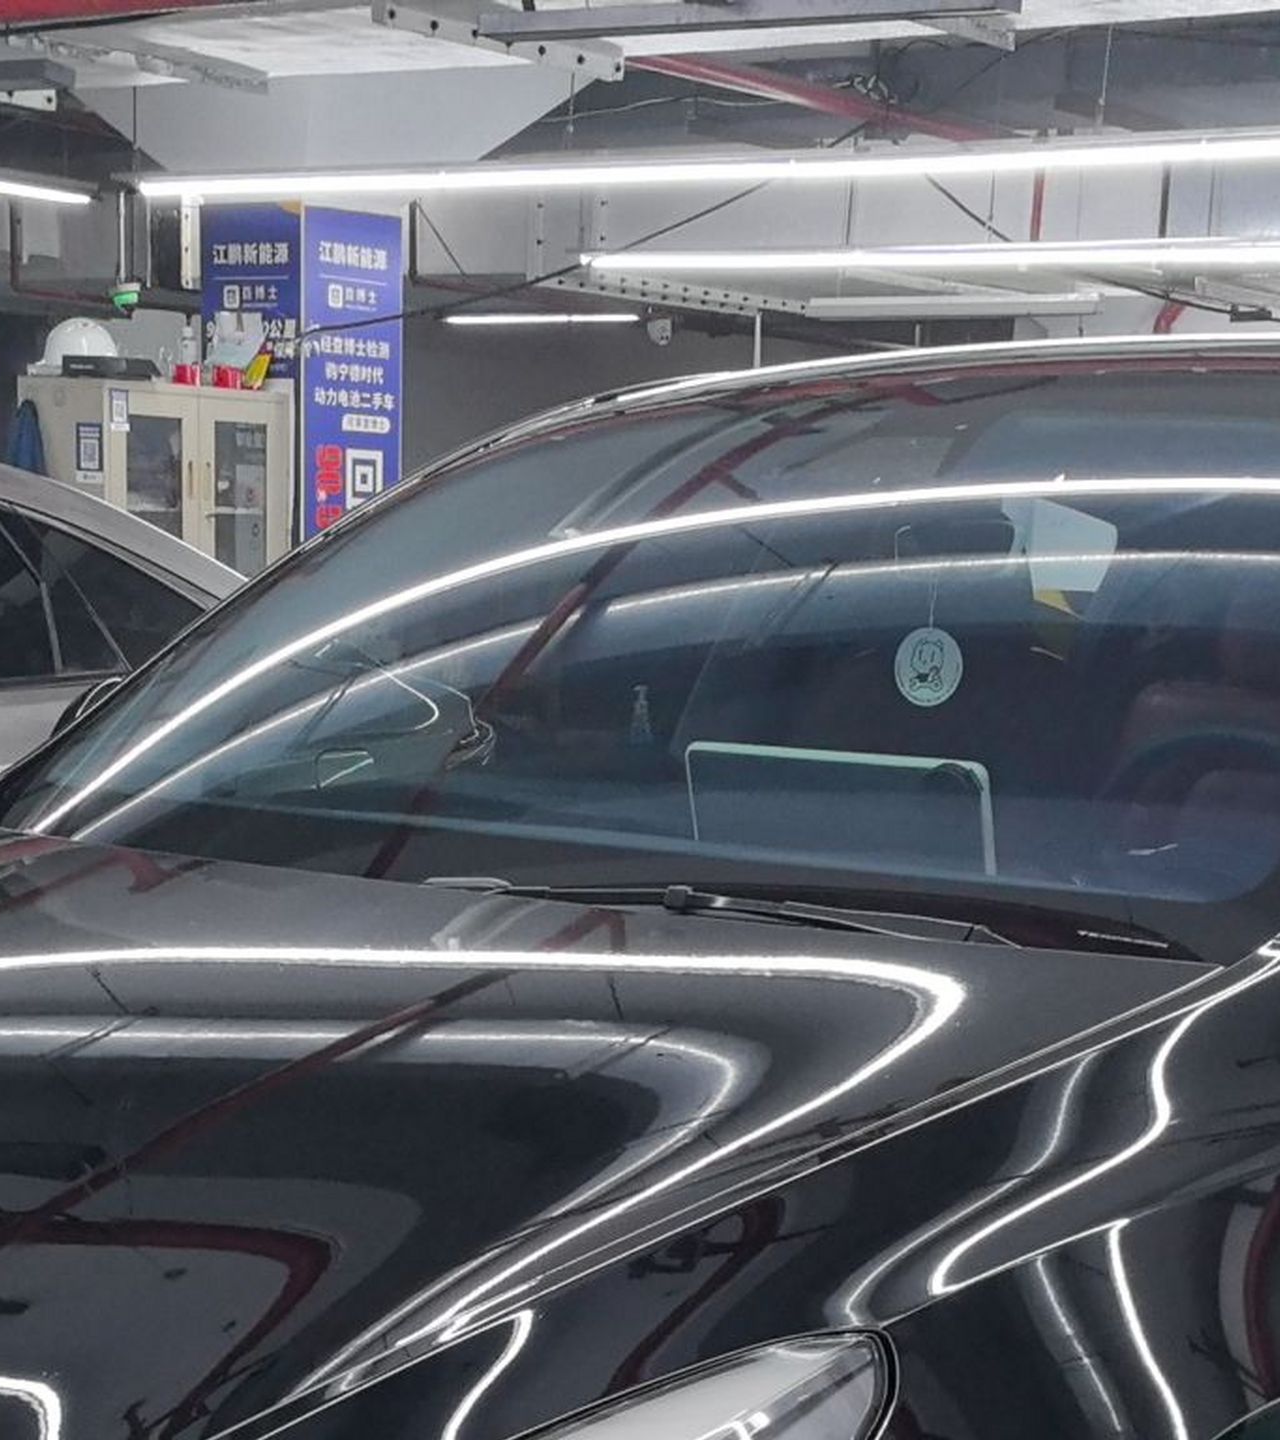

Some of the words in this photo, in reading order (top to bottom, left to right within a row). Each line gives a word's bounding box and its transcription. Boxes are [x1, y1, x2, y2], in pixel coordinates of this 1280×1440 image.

[212, 243, 289, 265] 江鹏新能源
[319, 241, 388, 270] 江鹏新能源
[314, 387, 395, 411] 动力电池二手车
